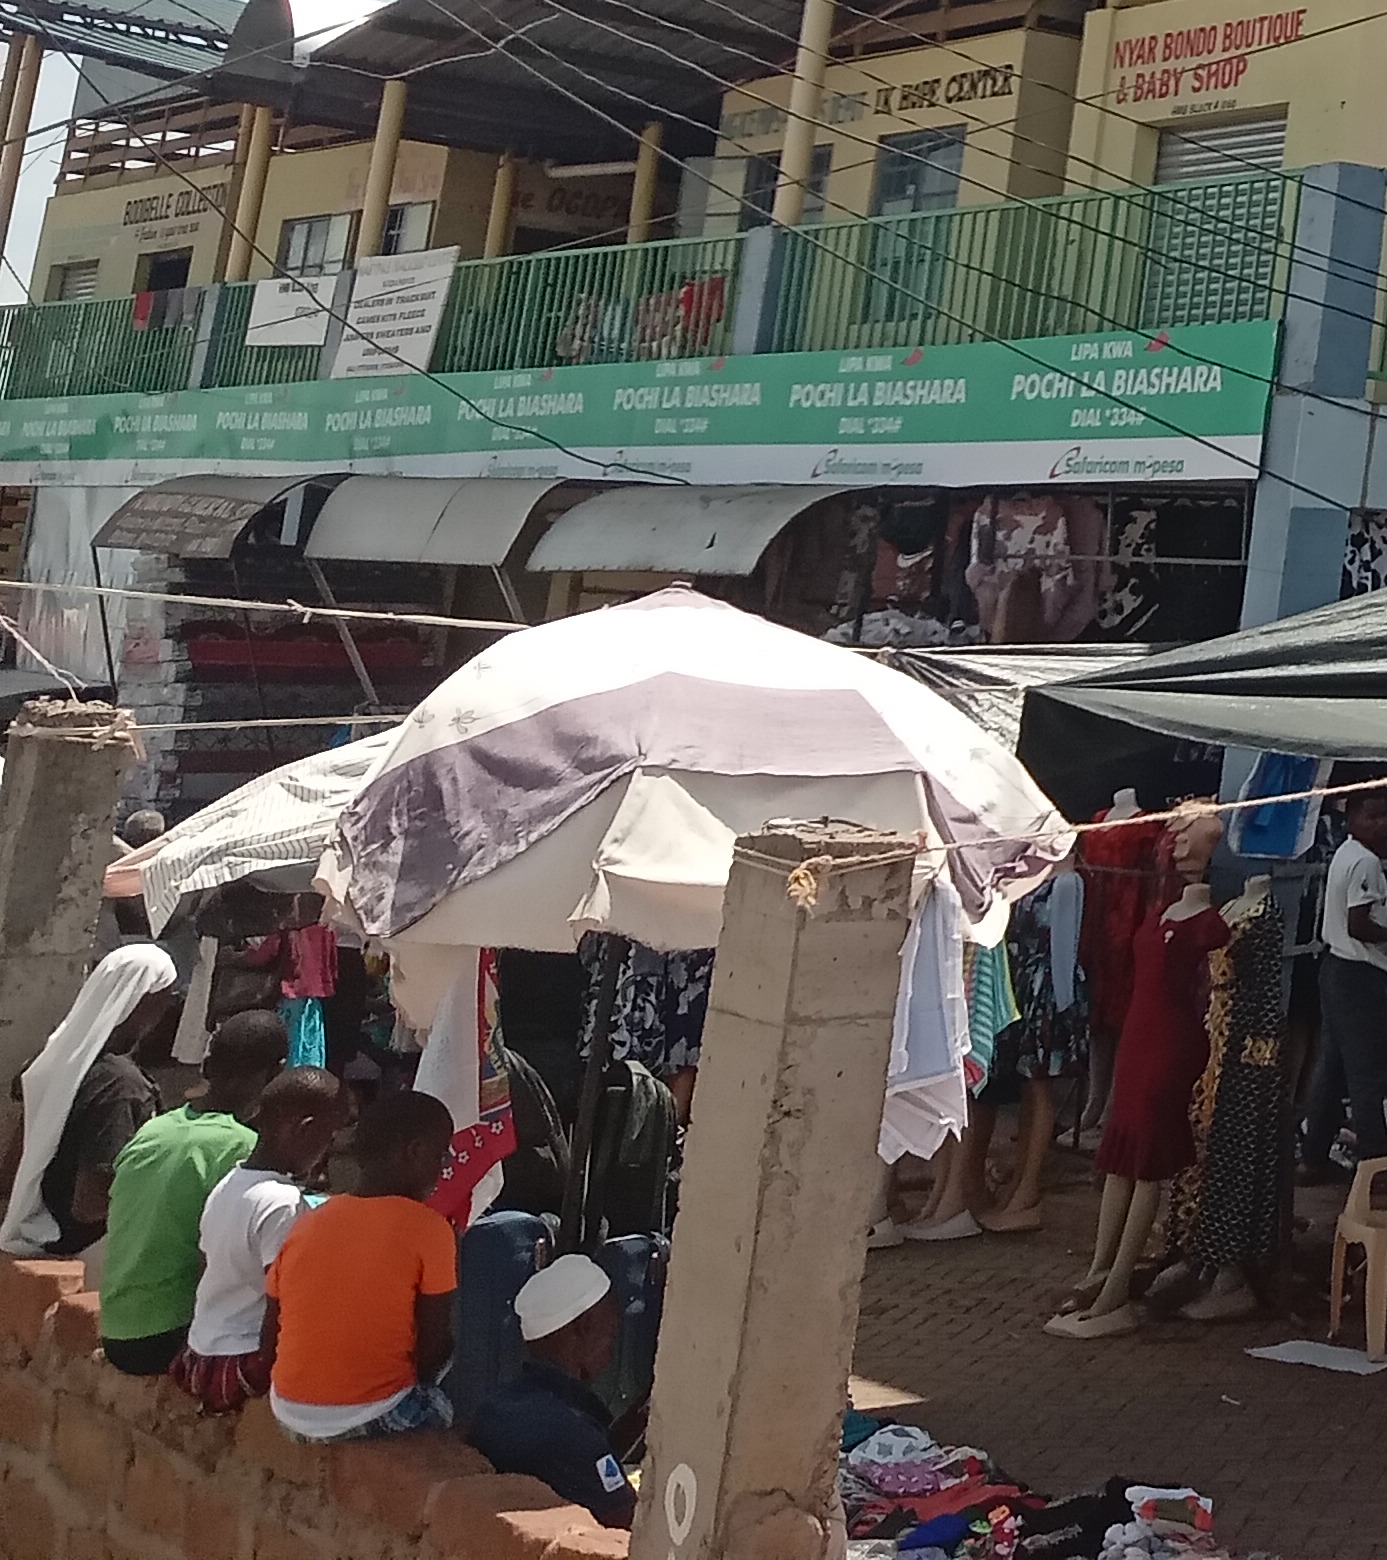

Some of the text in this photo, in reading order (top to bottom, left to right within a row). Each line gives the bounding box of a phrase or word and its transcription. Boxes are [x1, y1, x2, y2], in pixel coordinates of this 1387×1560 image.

[1113, 8, 1307, 69] NYAR BONDO BOUTIQUE
[1116, 55, 1249, 104] & BABY SHOP
[1071, 340, 1133, 361] LIPA KWA
[613, 382, 761, 410] POCHI LA BIASHARA
[789, 378, 966, 407] POCHI LA BIASHARA
[1011, 365, 1222, 401] POCHI LA BIASHARA
[325, 405, 432, 432] POCHI LA BIASHARA
[457, 392, 584, 421] POCHI LA BIASHARA
[1070, 408, 1102, 428] DIAL
[1063, 454, 1130, 475] Safaricom
